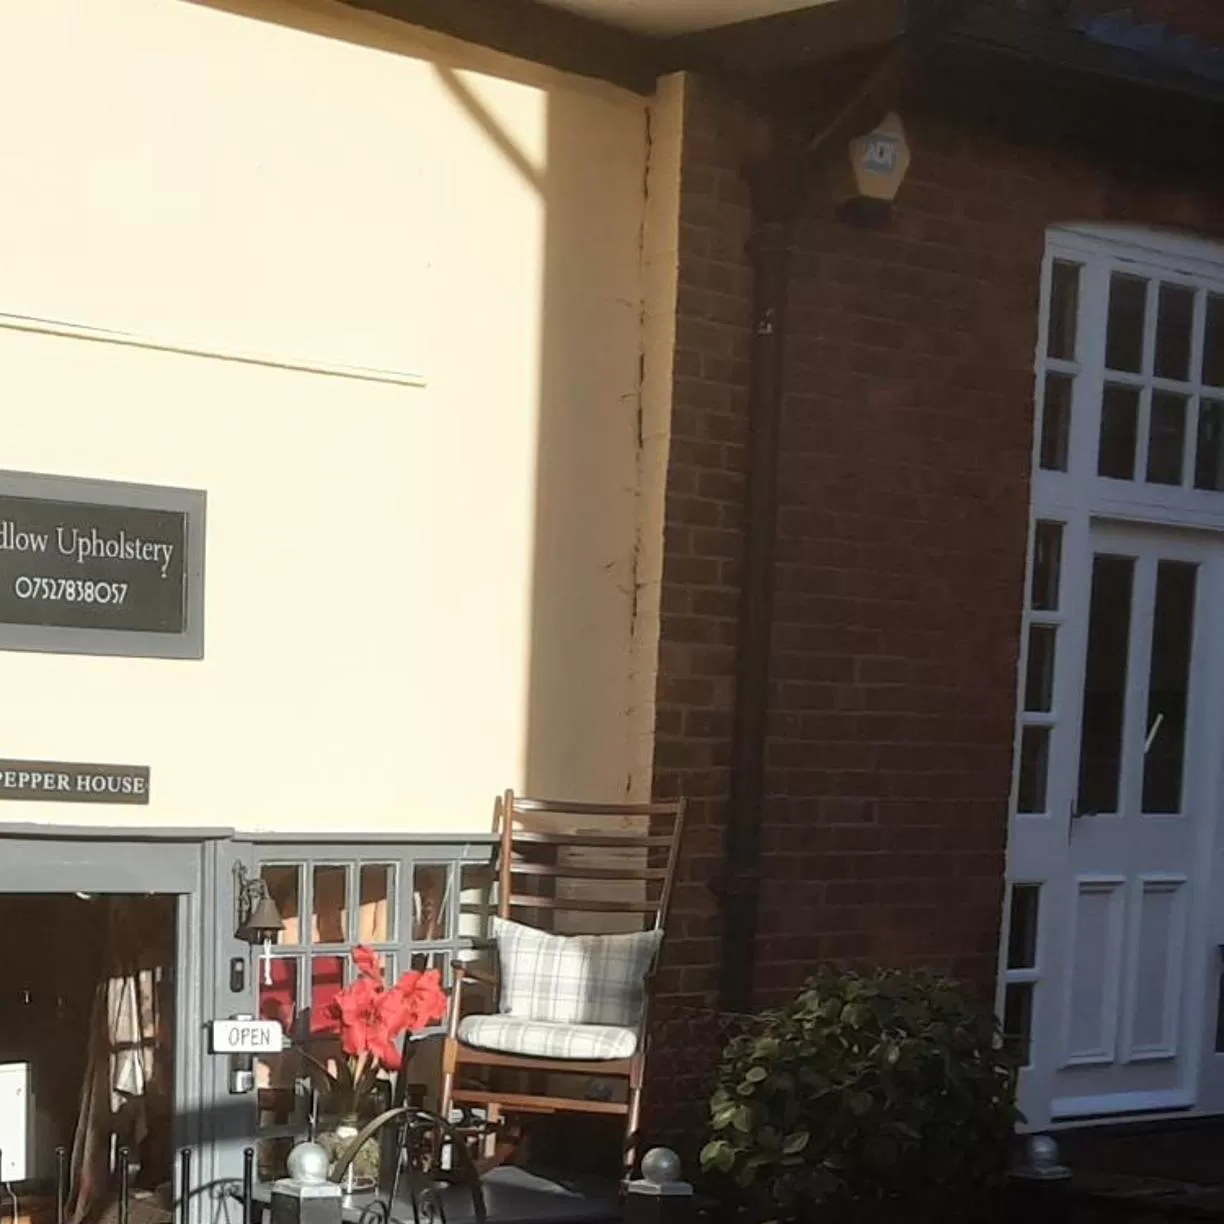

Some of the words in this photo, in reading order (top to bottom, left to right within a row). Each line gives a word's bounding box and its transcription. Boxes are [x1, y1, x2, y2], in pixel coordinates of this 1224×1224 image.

[55, 526, 174, 578] Upholstery
[15, 576, 128, 604] 07527838057
[75, 775, 146, 794] HOUSE
[228, 1027, 272, 1046] OPEN
